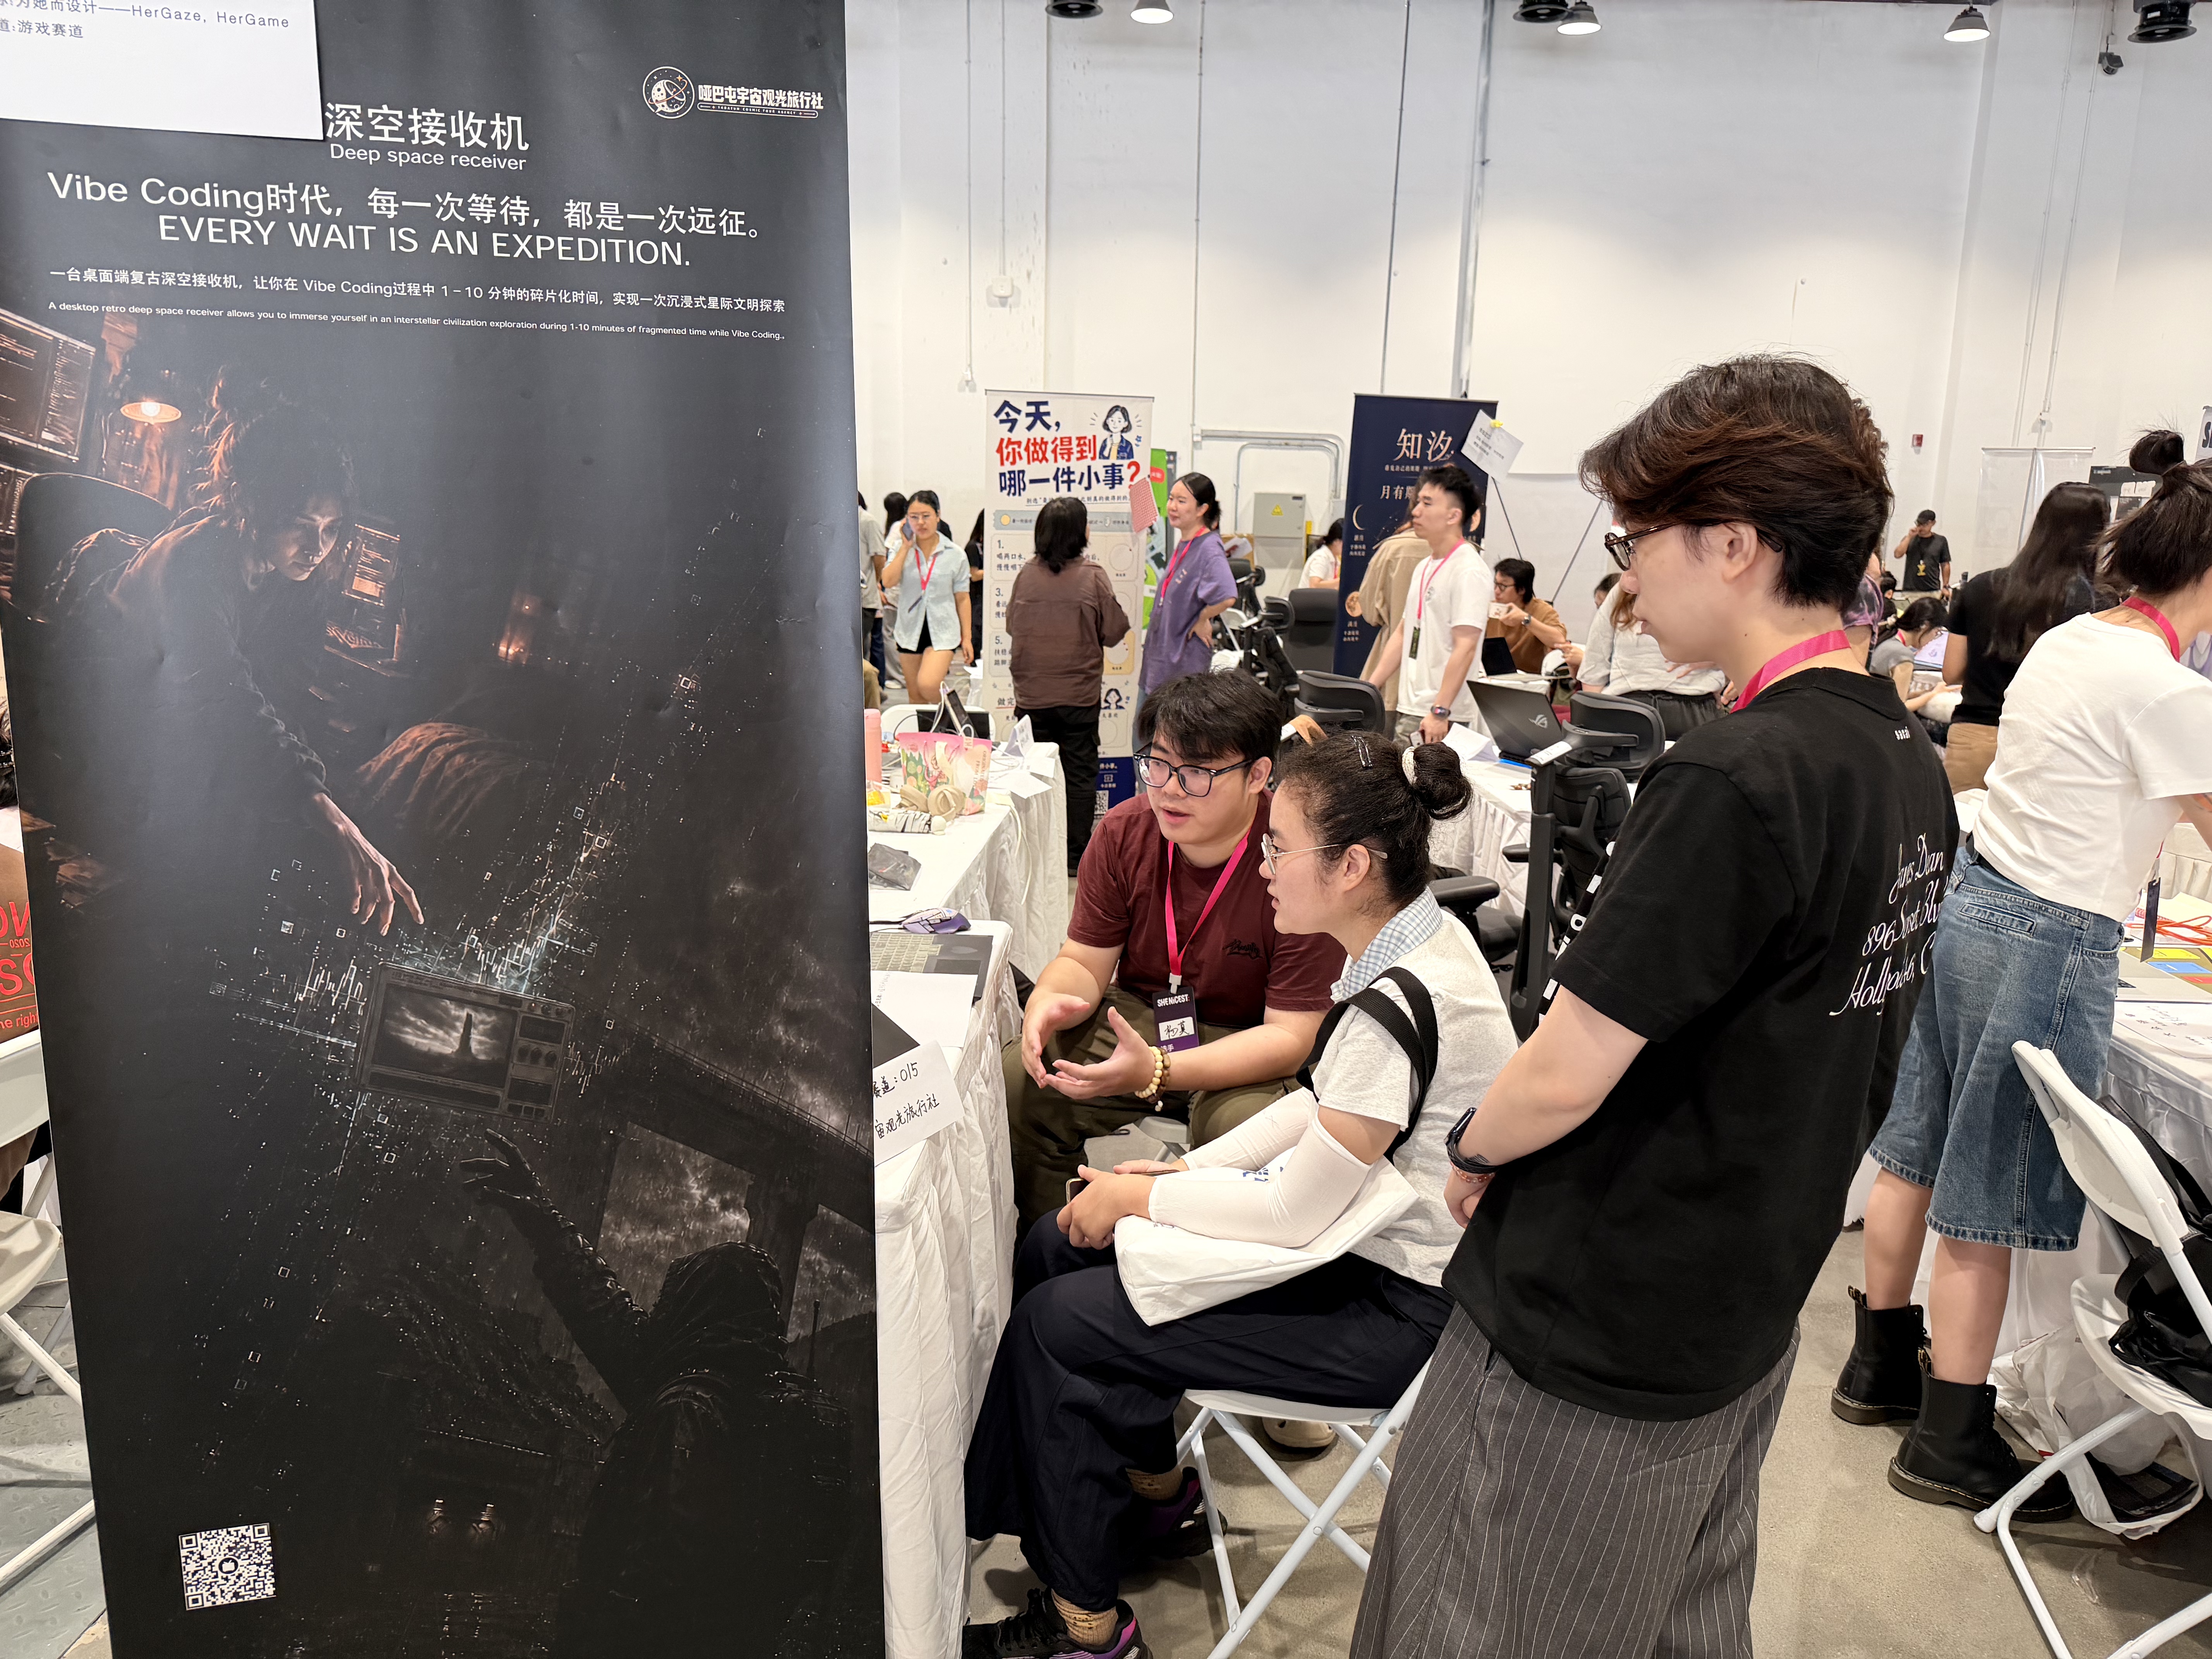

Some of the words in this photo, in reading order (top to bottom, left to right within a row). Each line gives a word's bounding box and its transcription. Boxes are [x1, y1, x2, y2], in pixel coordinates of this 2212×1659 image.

[217, 11, 289, 27] HerGame
[699, 85, 824, 109] 哑巴屯宇宙观光旅行社
[325, 103, 529, 151] 深空接收机
[331, 143, 380, 165] Deep
[388, 151, 444, 167] space
[451, 154, 526, 170] receiver
[47, 172, 127, 202] Vibe
[159, 215, 275, 245] EVERY
[288, 222, 376, 250] WAIT
[390, 227, 418, 252] IS
[431, 230, 478, 255] AN
[493, 233, 689, 266] EXPEDITION.
[303, 280, 336, 292] Vibe
[341, 281, 434, 297] Coding过程中
[59, 303, 99, 313] desktop
[101, 304, 126, 313] retro
[129, 306, 153, 315] deep
[156, 308, 183, 316] space
[186, 308, 223, 316] receiver
[290, 312, 328, 320] immerse
[331, 314, 367, 323] yourself
[394, 316, 440, 325] interstellar
[443, 318, 487, 326] civilization
[490, 321, 537, 329] exploration
[540, 323, 567, 332] during
[639, 326, 686, 335] fragmented
[994, 400, 1061, 433] 今天，
[996, 434, 1097, 466] 你做得到
[1393, 428, 1454, 462] 知汐
[998, 539, 1004, 549] 1.
[995, 588, 1003, 596] 3.
[995, 635, 1002, 644] 5.
[1862, 919, 1897, 956] 896
